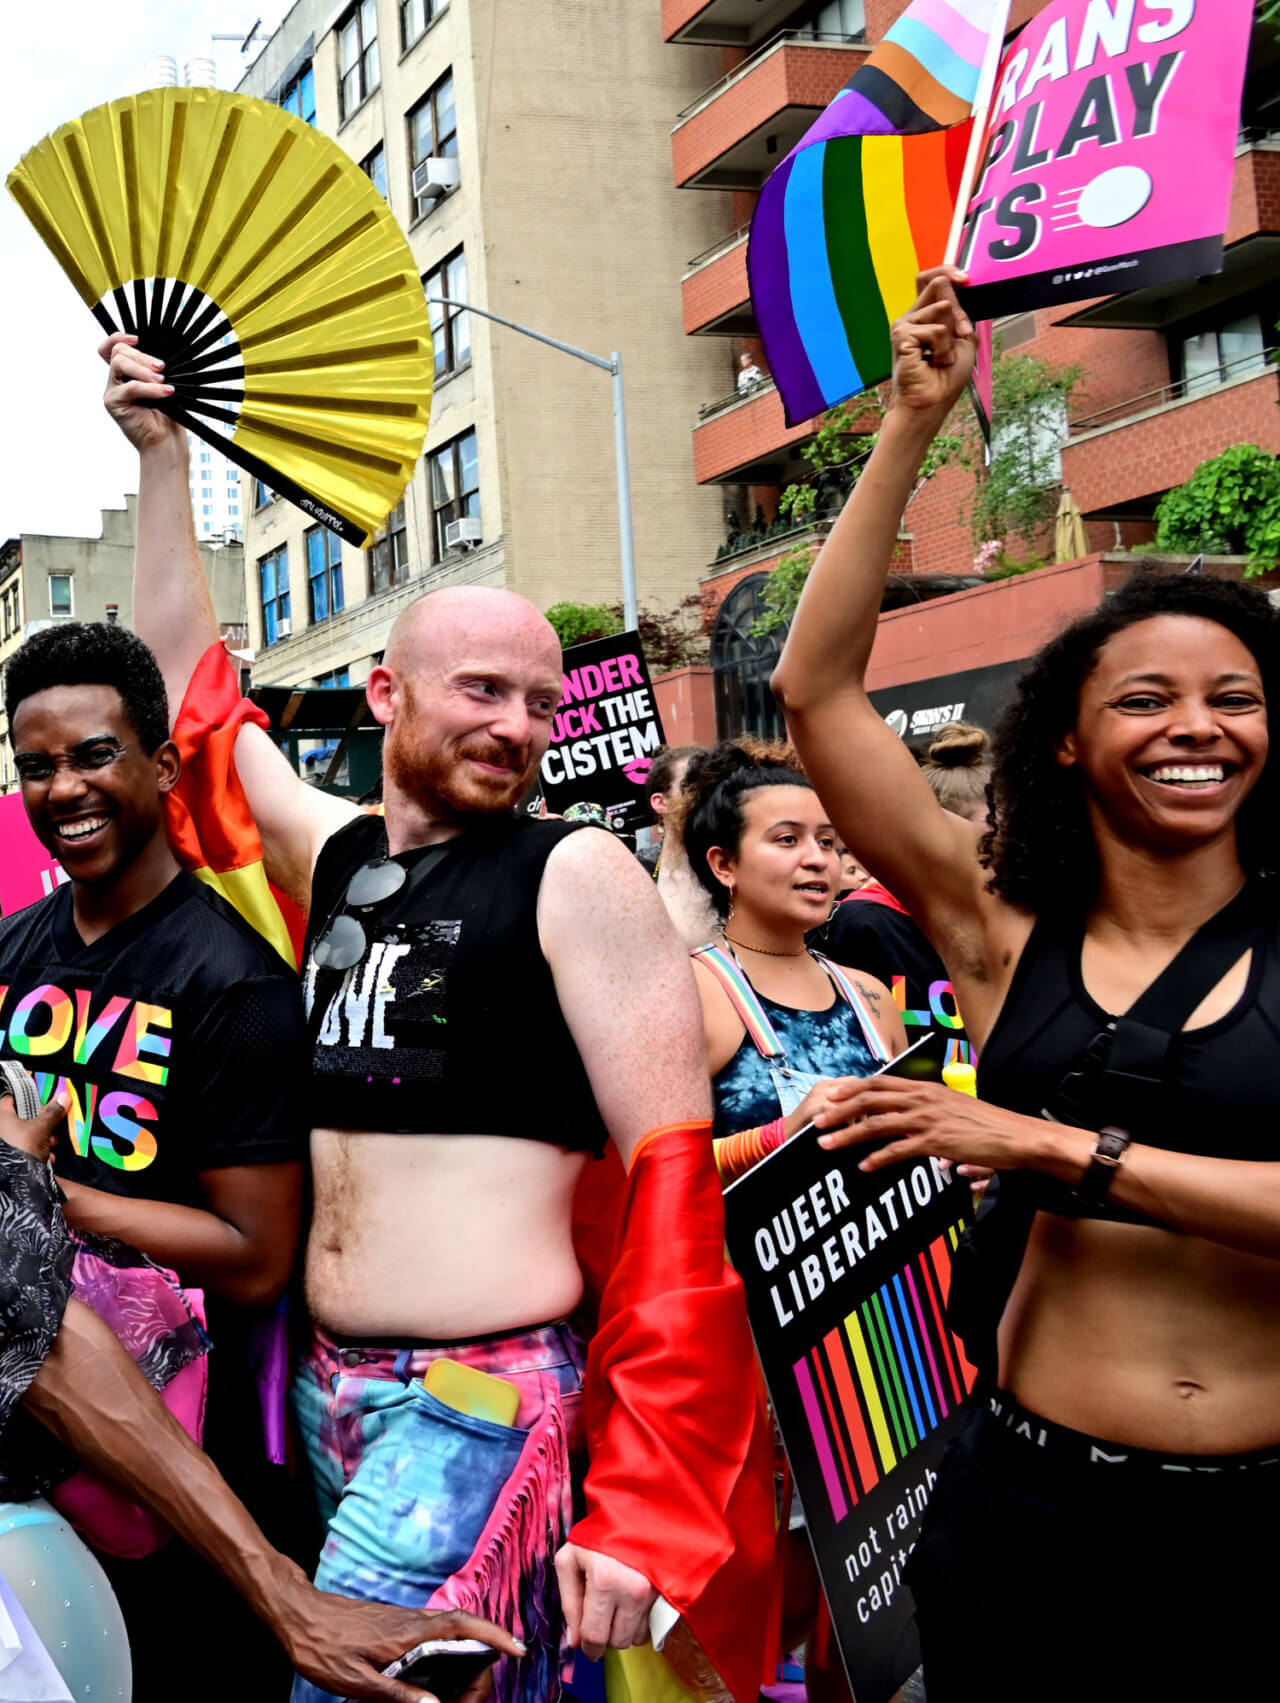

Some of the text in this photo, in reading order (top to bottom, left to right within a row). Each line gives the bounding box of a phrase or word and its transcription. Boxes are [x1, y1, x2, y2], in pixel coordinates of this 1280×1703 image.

[989, 0, 1196, 129] RANS
[971, 50, 1185, 201] PLAY
[557, 653, 645, 707] NDER
[550, 688, 654, 743] UCK THE
[540, 721, 662, 785] CISTEM
[891, 975, 965, 1030] LO
[754, 1168, 851, 1272] QUEER
[770, 1156, 953, 1328] LIBERATION
[845, 1526, 882, 1583] not
